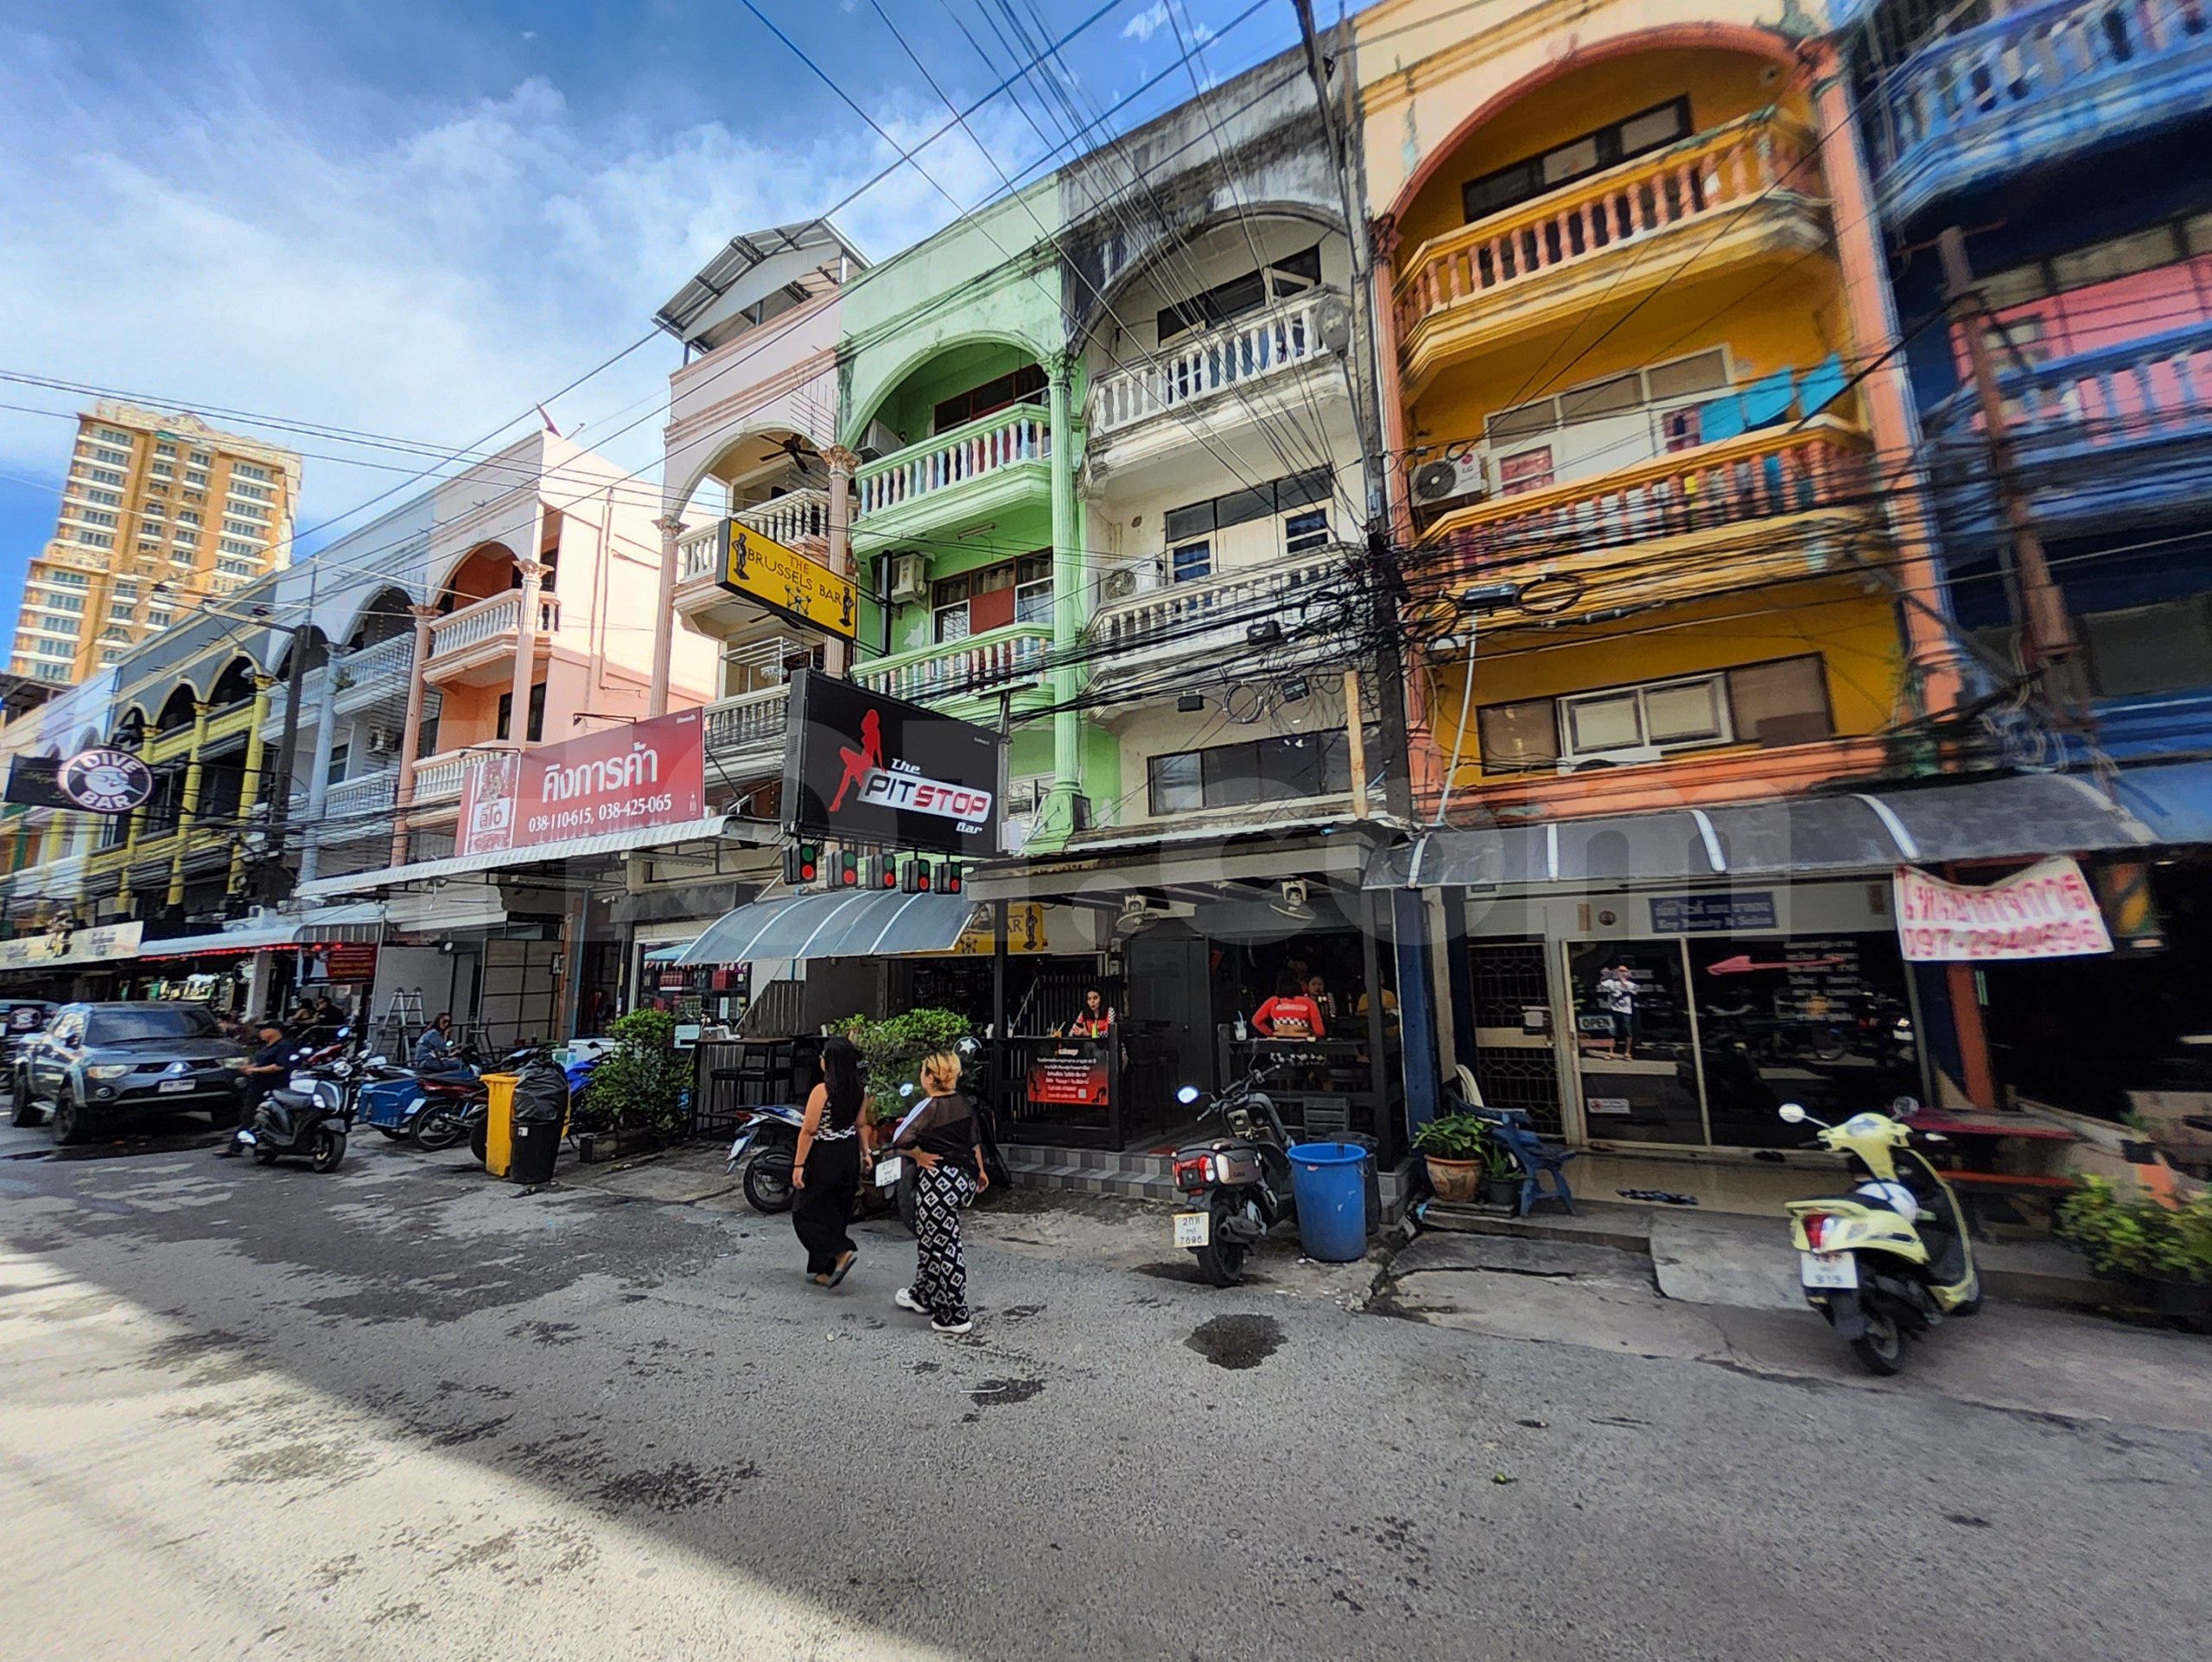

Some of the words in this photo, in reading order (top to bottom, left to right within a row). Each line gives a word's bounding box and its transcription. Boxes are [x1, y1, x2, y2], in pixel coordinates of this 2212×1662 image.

[788, 554, 810, 575] THE
[747, 550, 813, 591] BRUSSELS
[819, 584, 842, 605] BAR
[80, 754, 141, 774] DIVE
[542, 742, 658, 804] คิงการค้า
[891, 758, 921, 775] The
[79, 790, 131, 809] BAR
[528, 806, 594, 834] 038-110-615,
[598, 793, 672, 822] 038-425-065
[956, 822, 982, 835] Bar
[1583, 1017, 1610, 1028] OPEN
